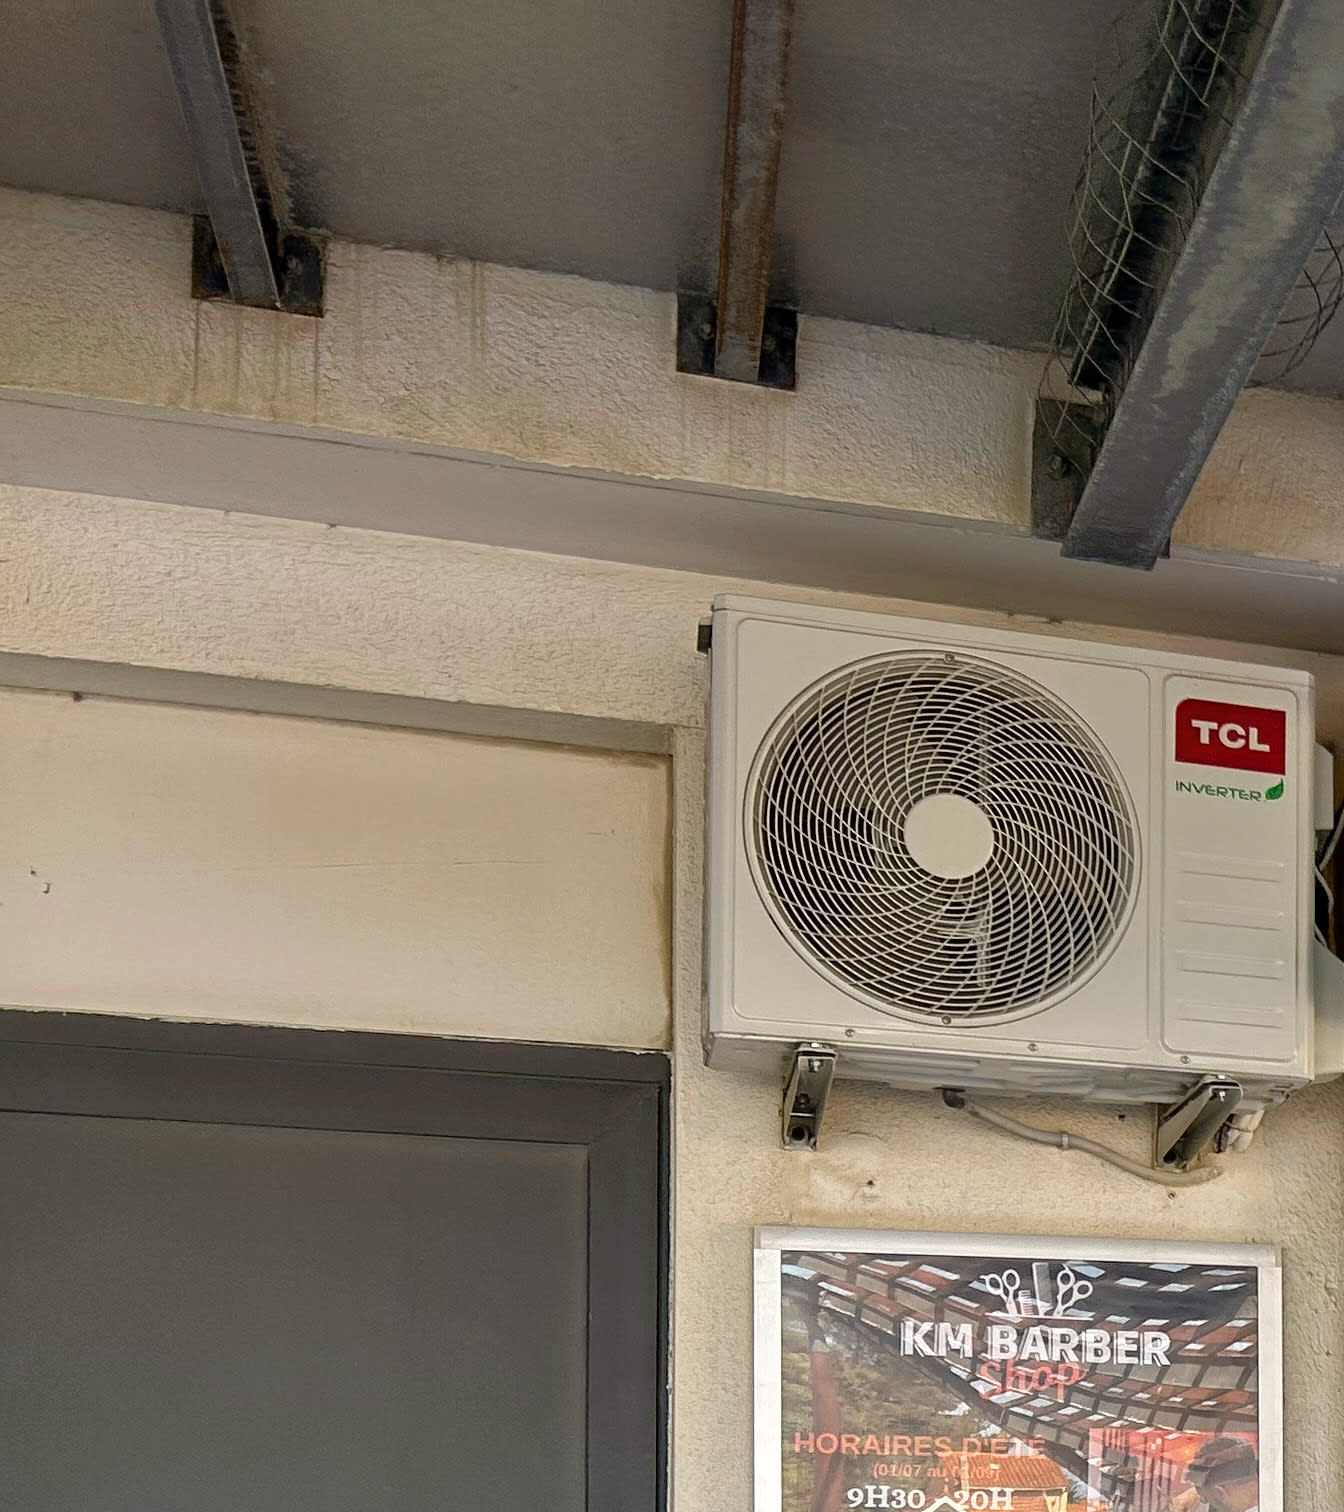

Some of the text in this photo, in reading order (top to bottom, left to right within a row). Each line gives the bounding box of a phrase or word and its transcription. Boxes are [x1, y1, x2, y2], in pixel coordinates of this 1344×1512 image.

[1191, 719, 1270, 752] TCL
[1175, 779, 1262, 802] INVERTER
[901, 1319, 1172, 1368] KM BARBER
[794, 1432, 953, 1457] HORAIRES
[846, 1485, 1015, 1511] 9H30 20H
